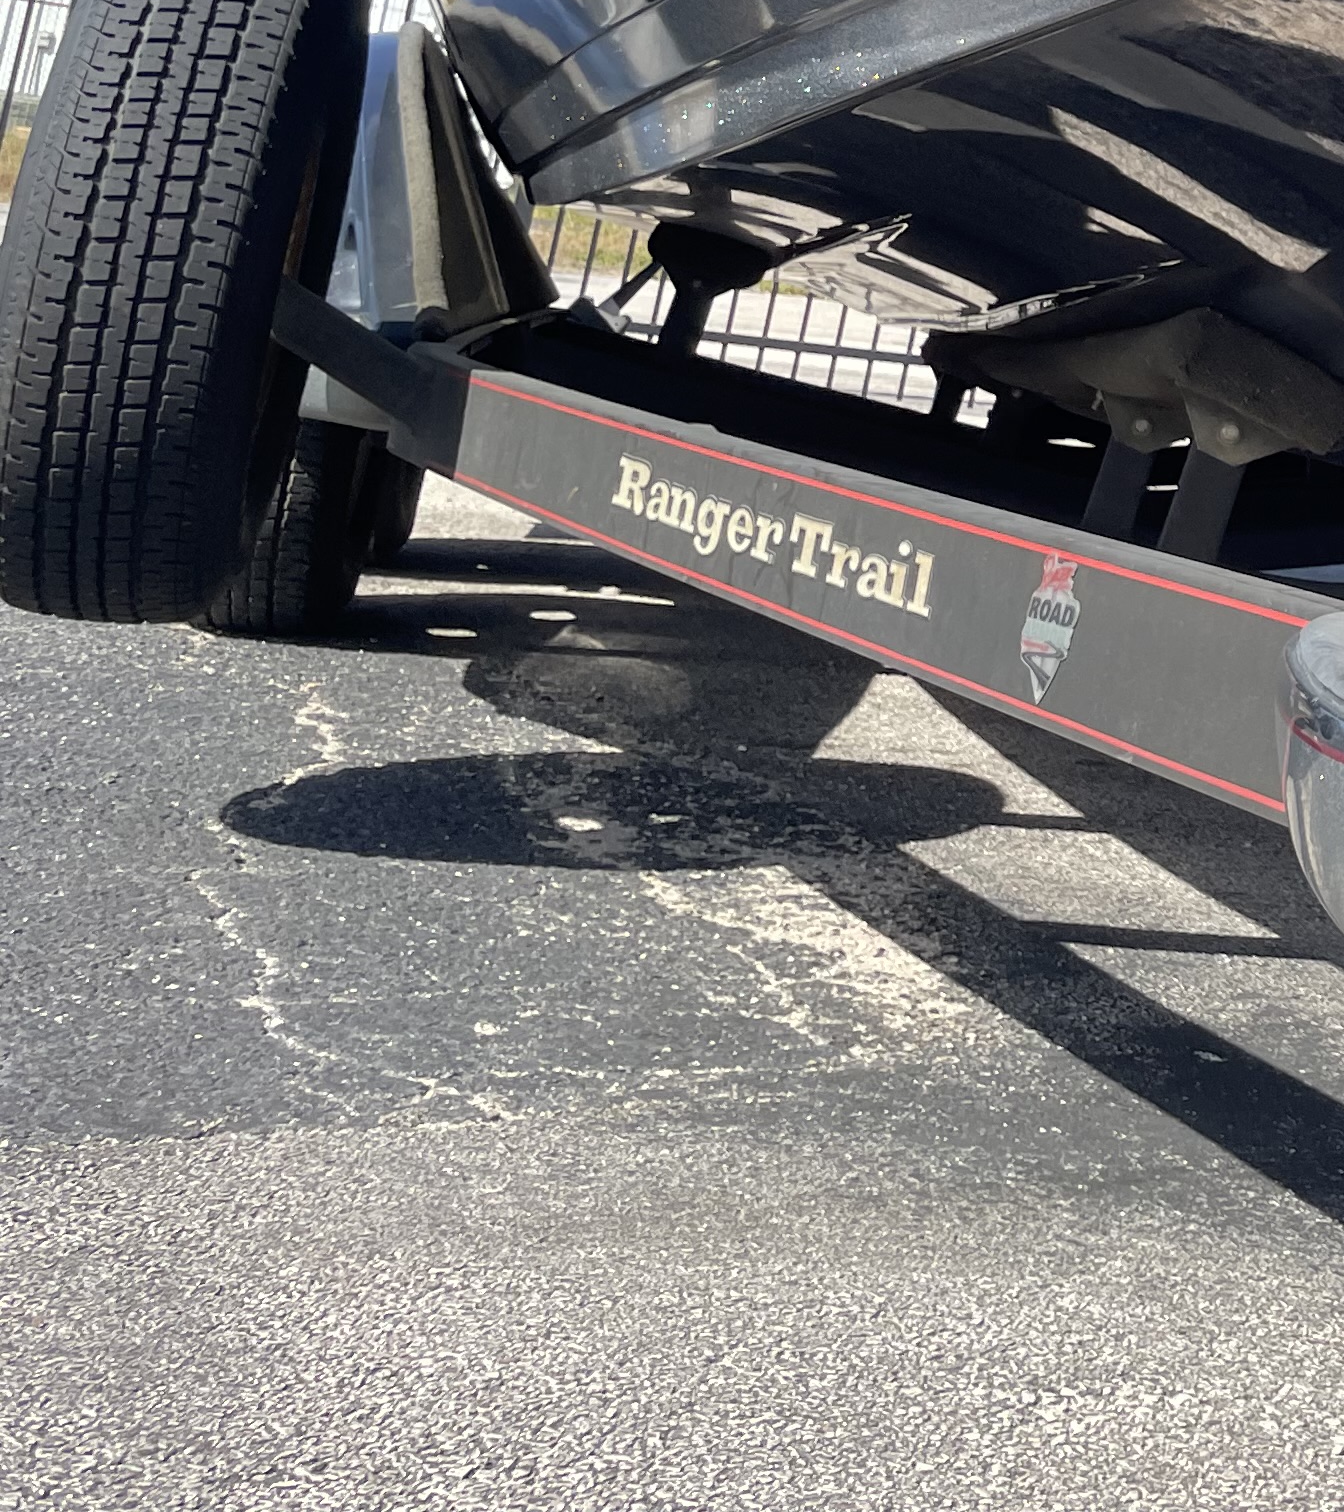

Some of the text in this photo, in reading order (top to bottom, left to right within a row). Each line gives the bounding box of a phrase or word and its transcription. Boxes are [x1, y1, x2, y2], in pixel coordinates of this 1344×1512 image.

[611, 452, 937, 620] Ranger Trail
[1028, 595, 1077, 628] ROAD
